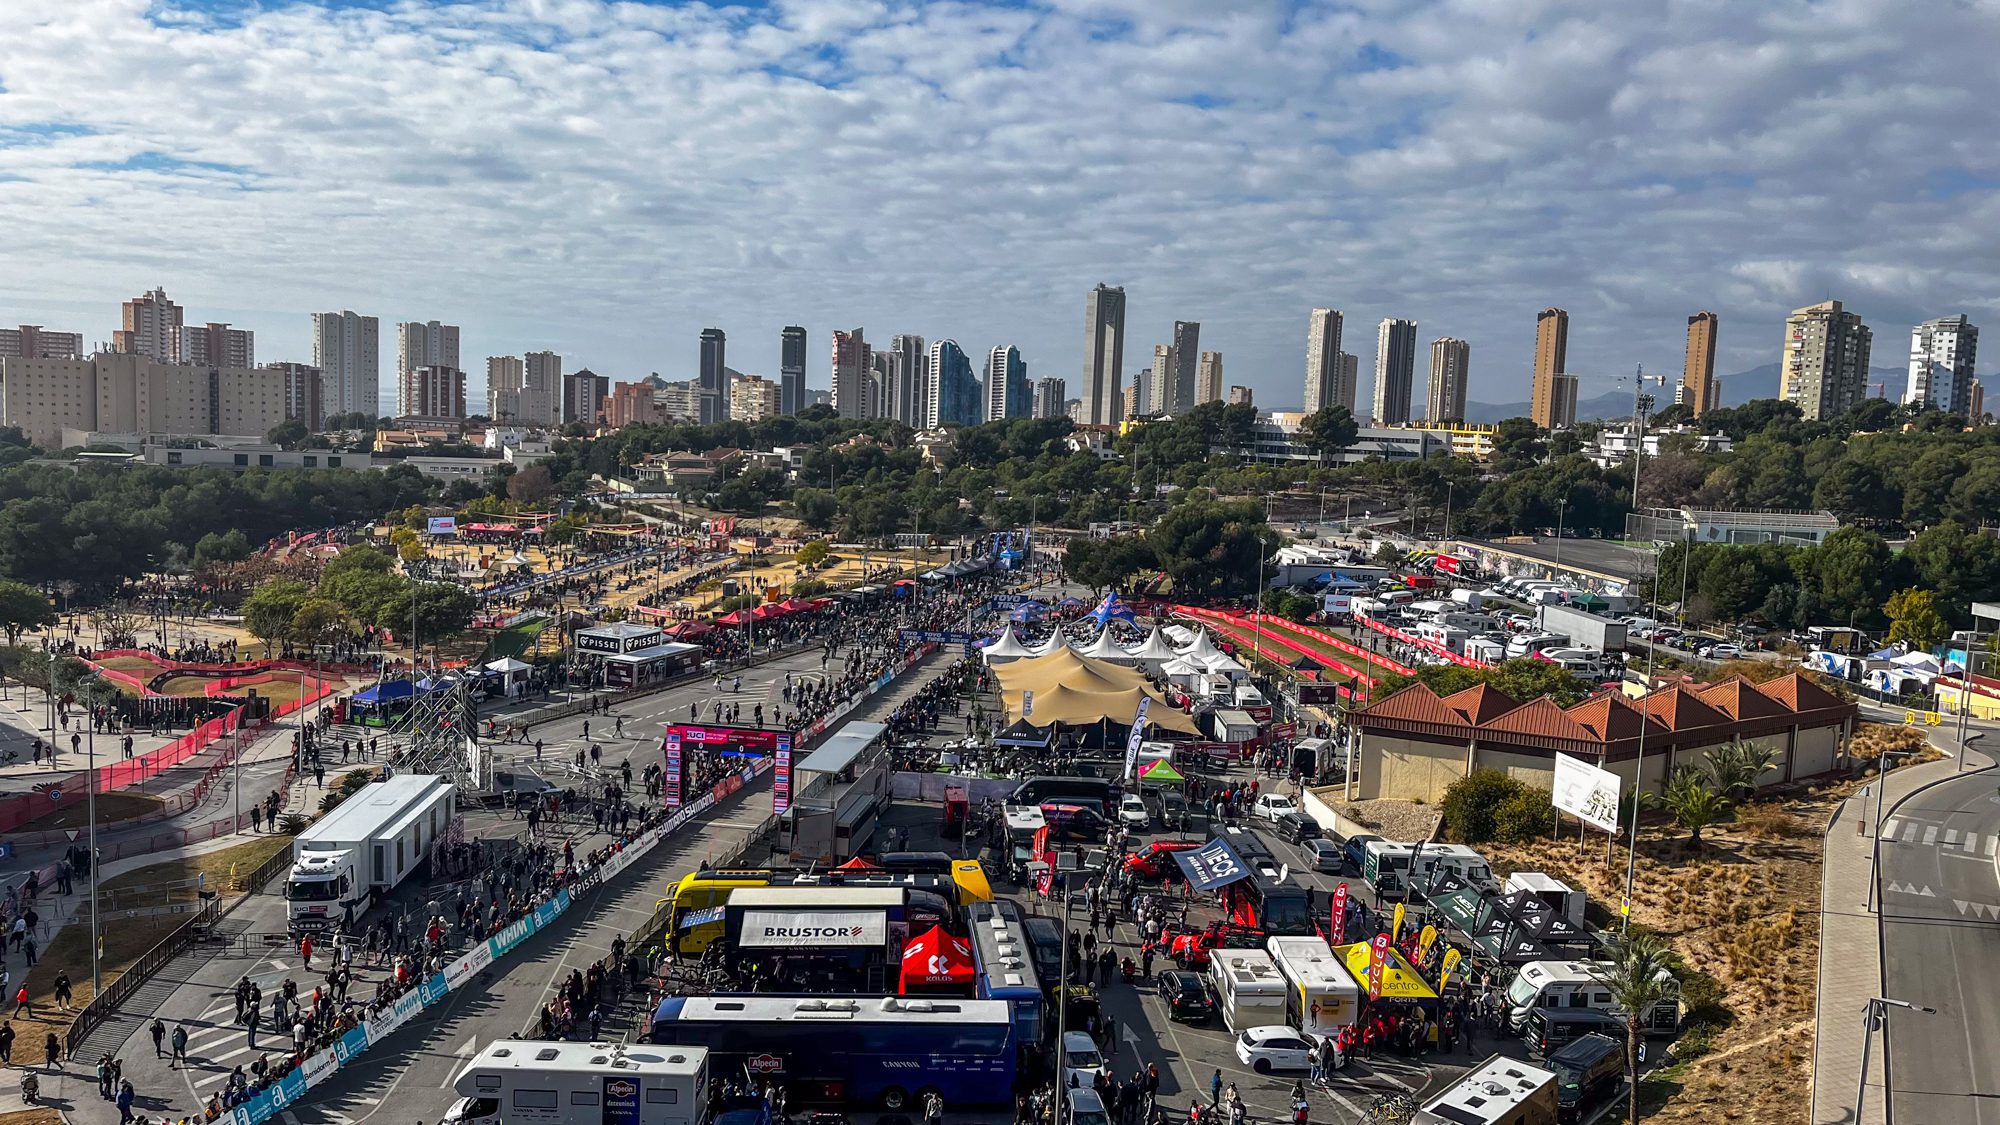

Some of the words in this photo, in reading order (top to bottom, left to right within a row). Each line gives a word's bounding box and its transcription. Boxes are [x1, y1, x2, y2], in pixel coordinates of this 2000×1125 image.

[993, 594, 1020, 602] TOYO
[589, 639, 618, 650] PISSEI
[634, 635, 659, 648] PISSEI
[685, 792, 715, 818] SHIMANO
[657, 809, 686, 839] SHIMANO
[1200, 846, 1239, 878] INEOS
[1333, 900, 1344, 940] ZYCLE
[494, 920, 528, 949] WHIM
[764, 927, 849, 937] BRUSTOR
[1371, 951, 1385, 995] ZYCLE
[1382, 982, 1419, 991] centro
[394, 991, 420, 1017] WHIM
[304, 1060, 331, 1081] Benidorm
[751, 1059, 779, 1068] Alpecin
[610, 1085, 633, 1093] Alpecin
